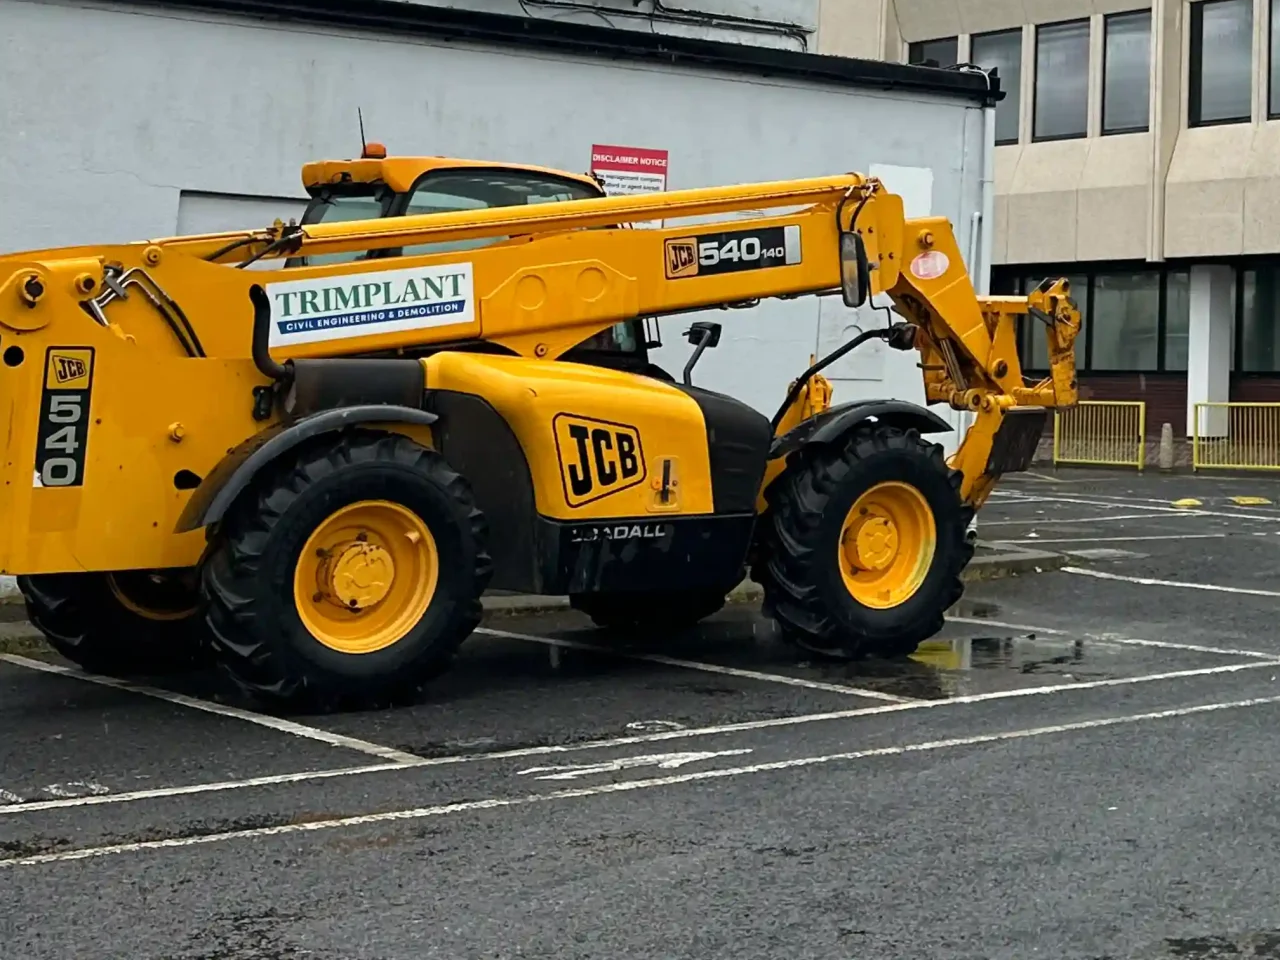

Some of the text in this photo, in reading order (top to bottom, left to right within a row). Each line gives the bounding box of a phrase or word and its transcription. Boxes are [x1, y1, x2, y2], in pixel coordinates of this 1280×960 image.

[592, 154, 667, 167] DISCLAIMER NOTICE
[670, 237, 784, 272] JCB 540 140
[275, 273, 466, 317] TRIMPLANT
[286, 303, 459, 331] CIVIL ENGINEERING & DEMOLITION
[57, 358, 85, 381] JCB
[42, 395, 82, 486] 540
[567, 423, 639, 497] JCB
